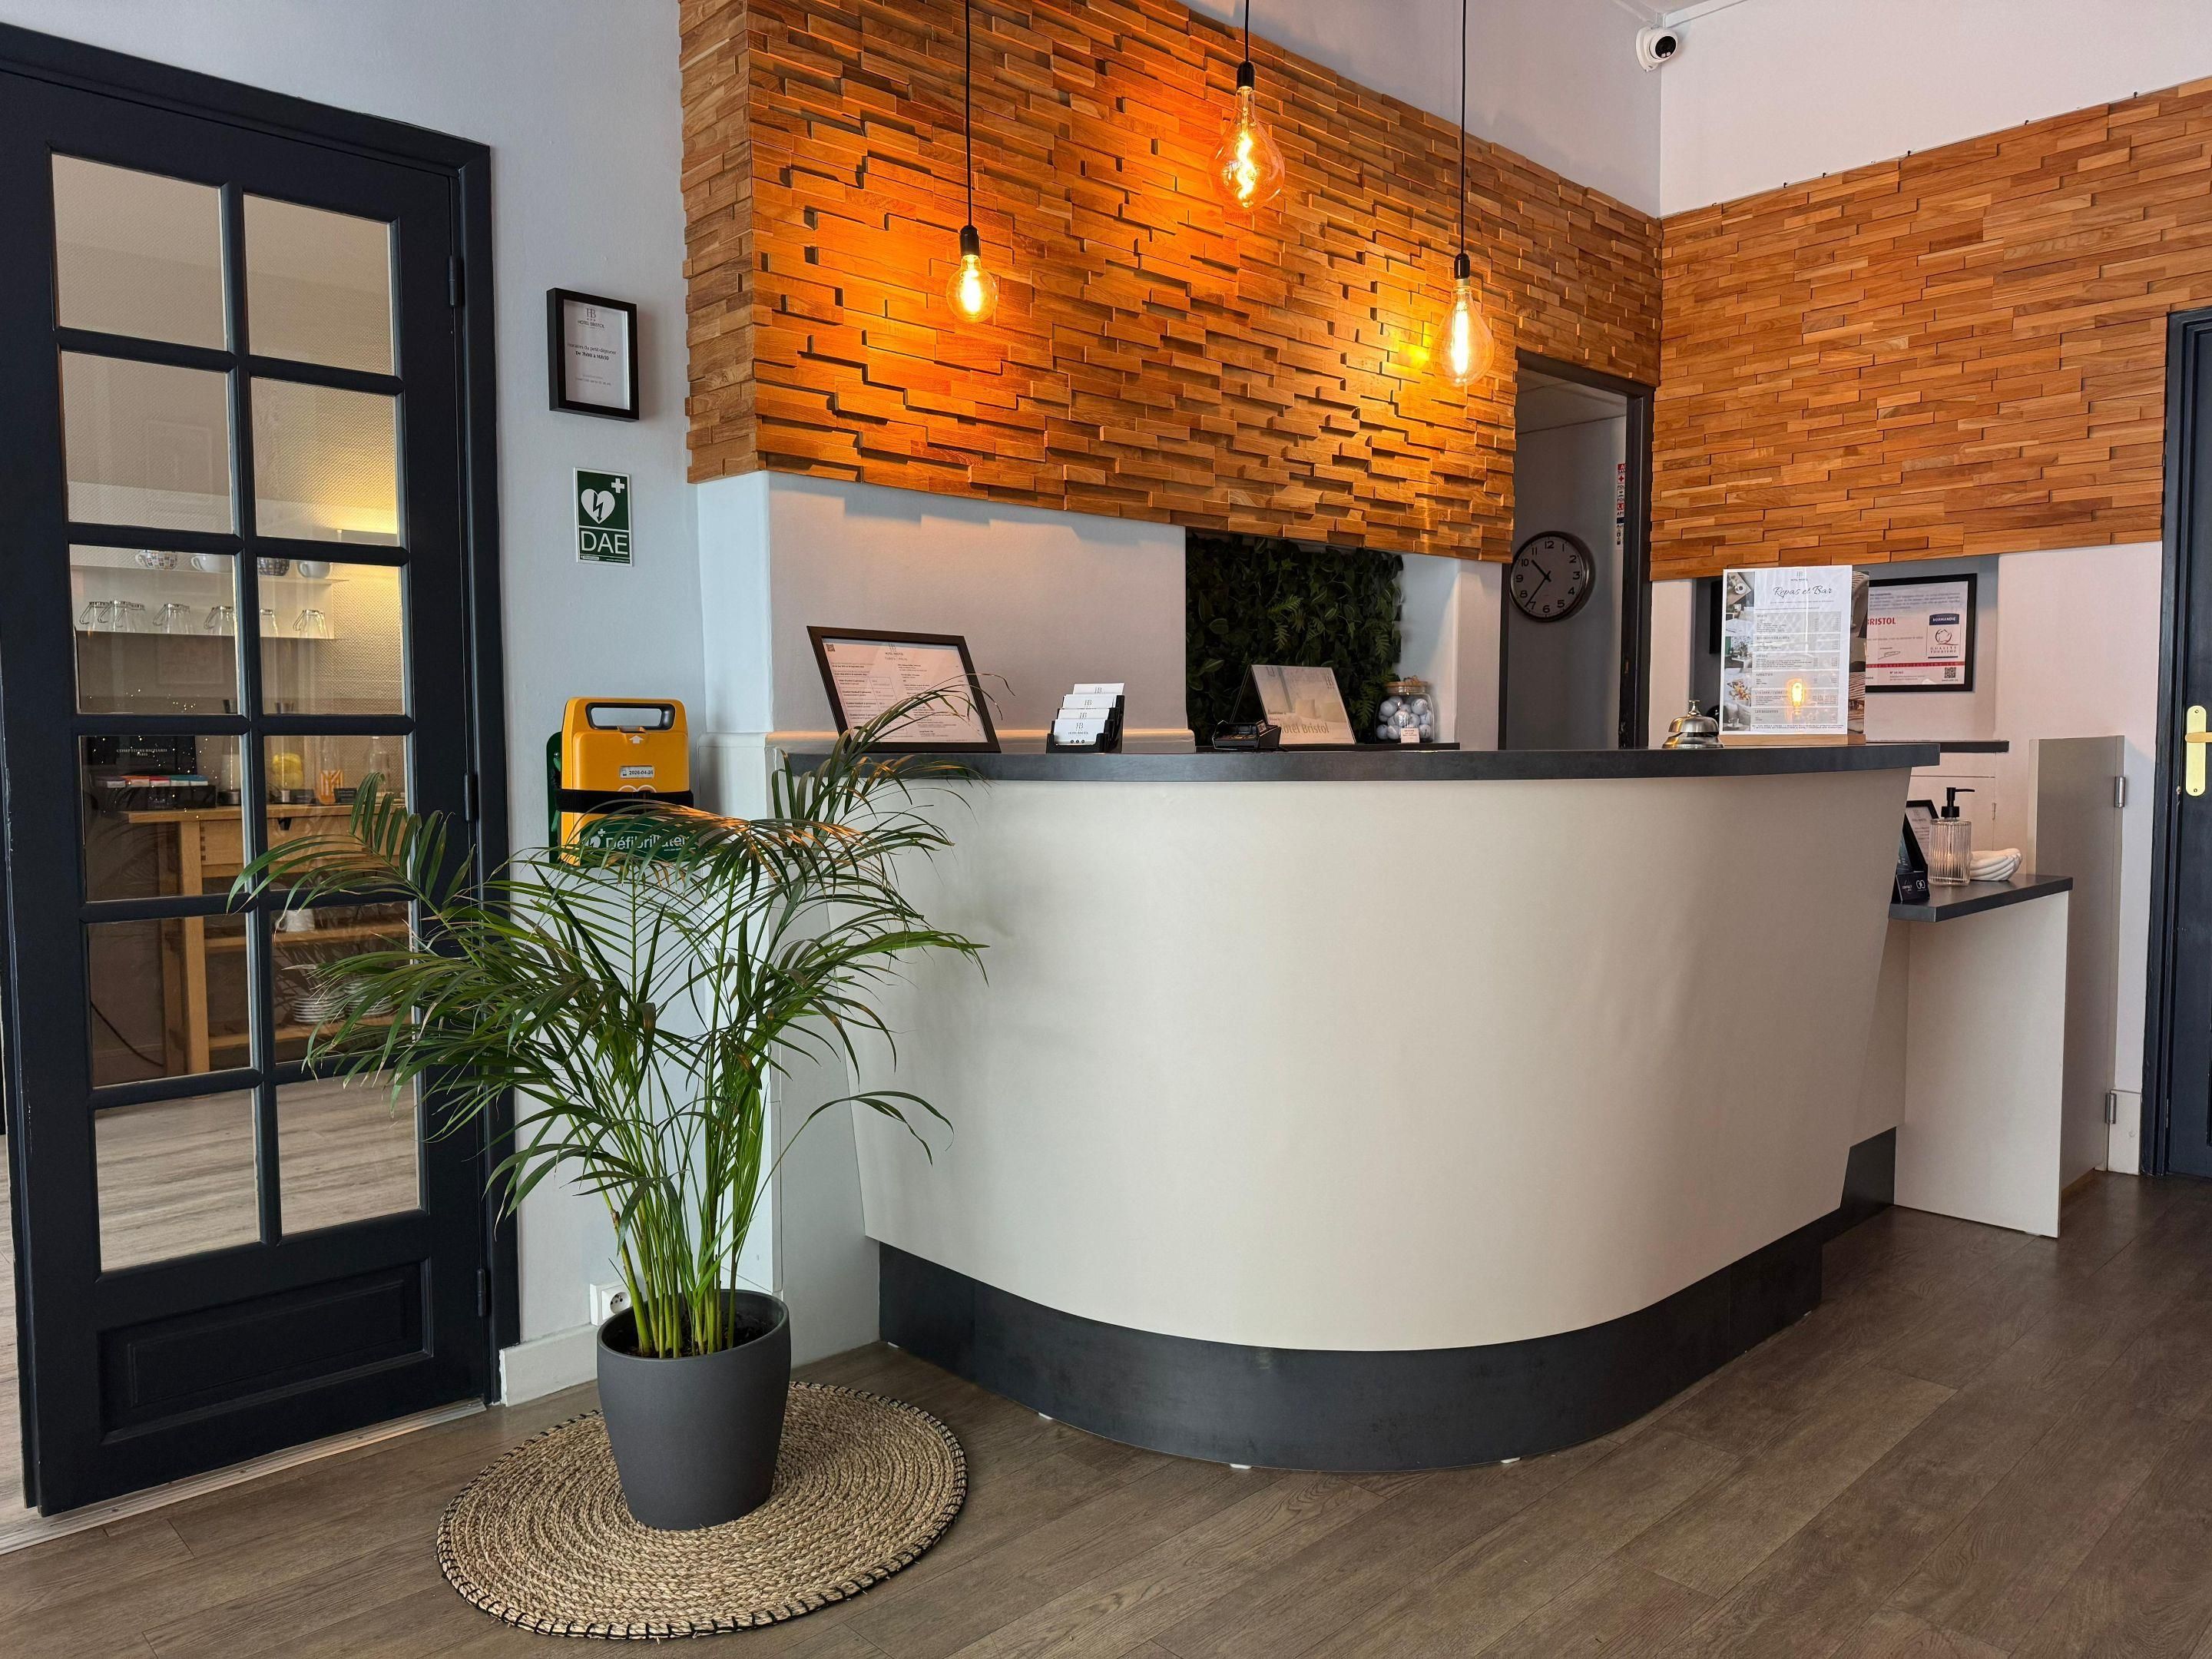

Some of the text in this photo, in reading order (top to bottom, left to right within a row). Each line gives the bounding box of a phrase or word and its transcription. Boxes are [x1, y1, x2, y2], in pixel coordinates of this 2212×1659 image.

[581, 531, 628, 555] DAE
[1545, 541, 1555, 549] 12
[1522, 558, 1529, 567] 10
[1569, 555, 1577, 564] 2
[1568, 587, 1575, 595] 4
[1773, 587, 1800, 598] Repas
[1812, 585, 1833, 594] Bar
[1302, 722, 1330, 734] Bristol
